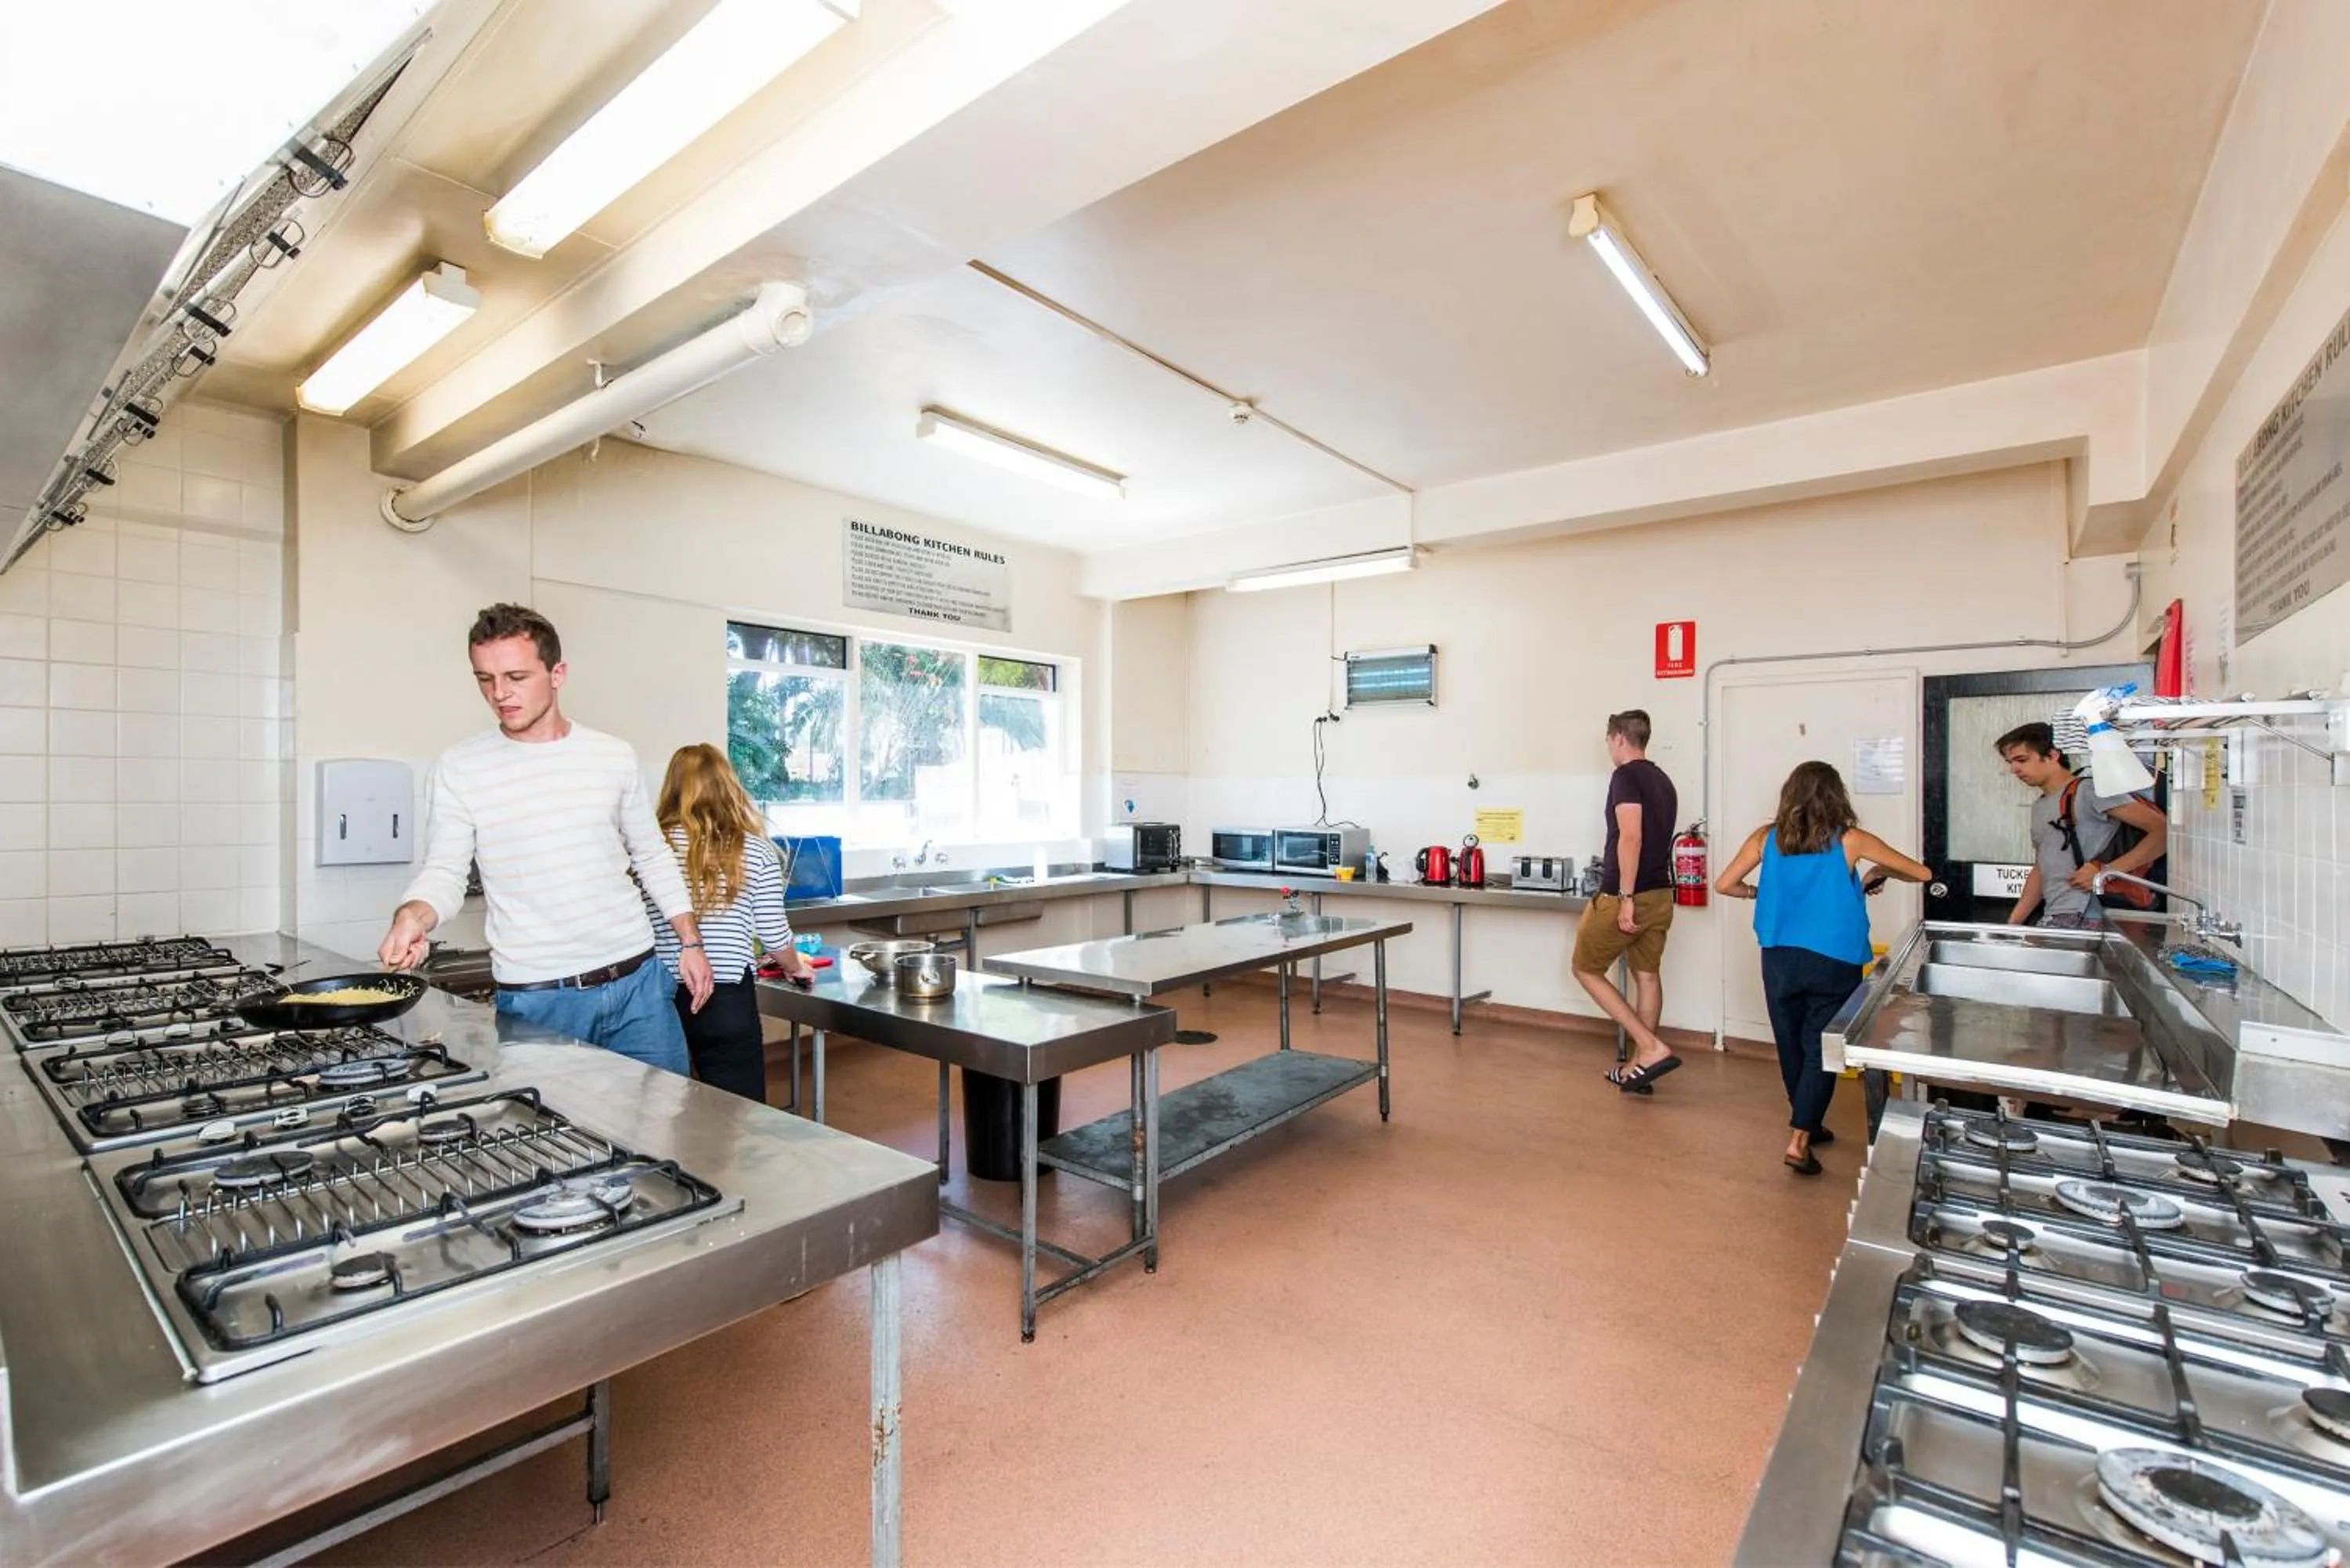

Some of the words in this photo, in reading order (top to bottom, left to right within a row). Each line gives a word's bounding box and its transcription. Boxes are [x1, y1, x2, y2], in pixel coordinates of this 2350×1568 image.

[851, 521, 920, 545] BILLABONG
[924, 538, 971, 557] KITCHEN
[974, 549, 1005, 565] RULES
[2294, 579, 2310, 602] YOU
[909, 607, 939, 618] THANK
[1997, 868, 2030, 879] TUCKE
